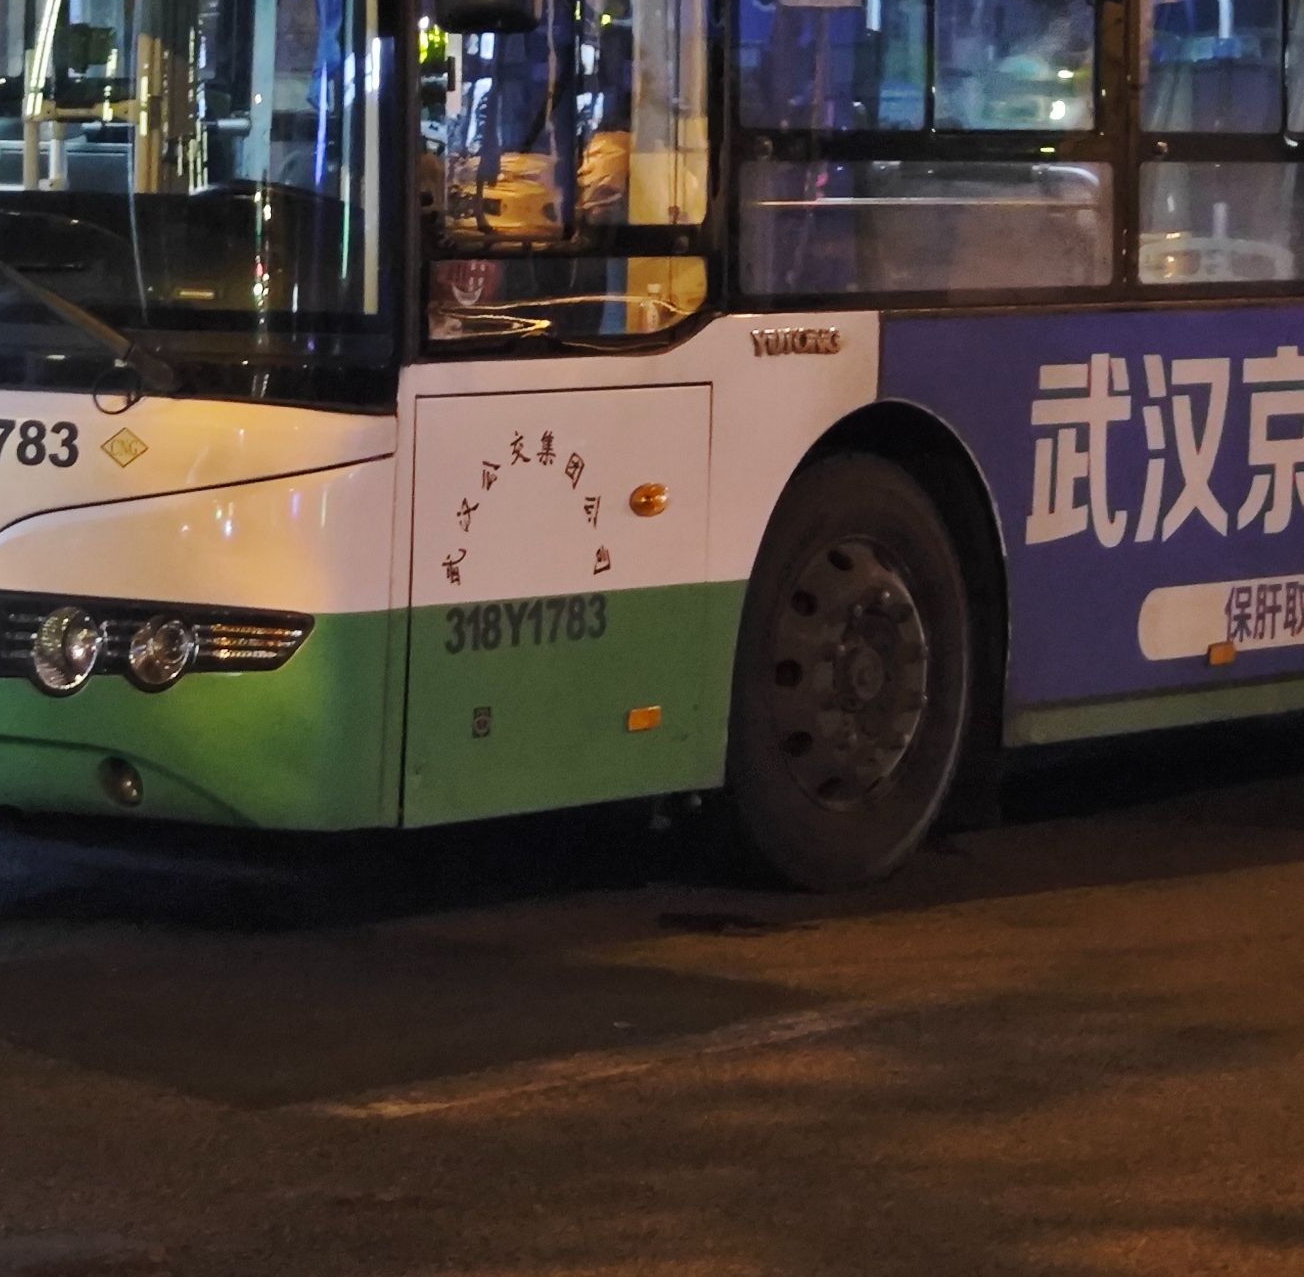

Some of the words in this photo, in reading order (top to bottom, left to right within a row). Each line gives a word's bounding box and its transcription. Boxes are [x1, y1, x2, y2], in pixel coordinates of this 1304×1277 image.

[750, 327, 841, 357] YUTONG
[109, 439, 139, 457] CNG
[445, 594, 607, 654] 318Y1783
